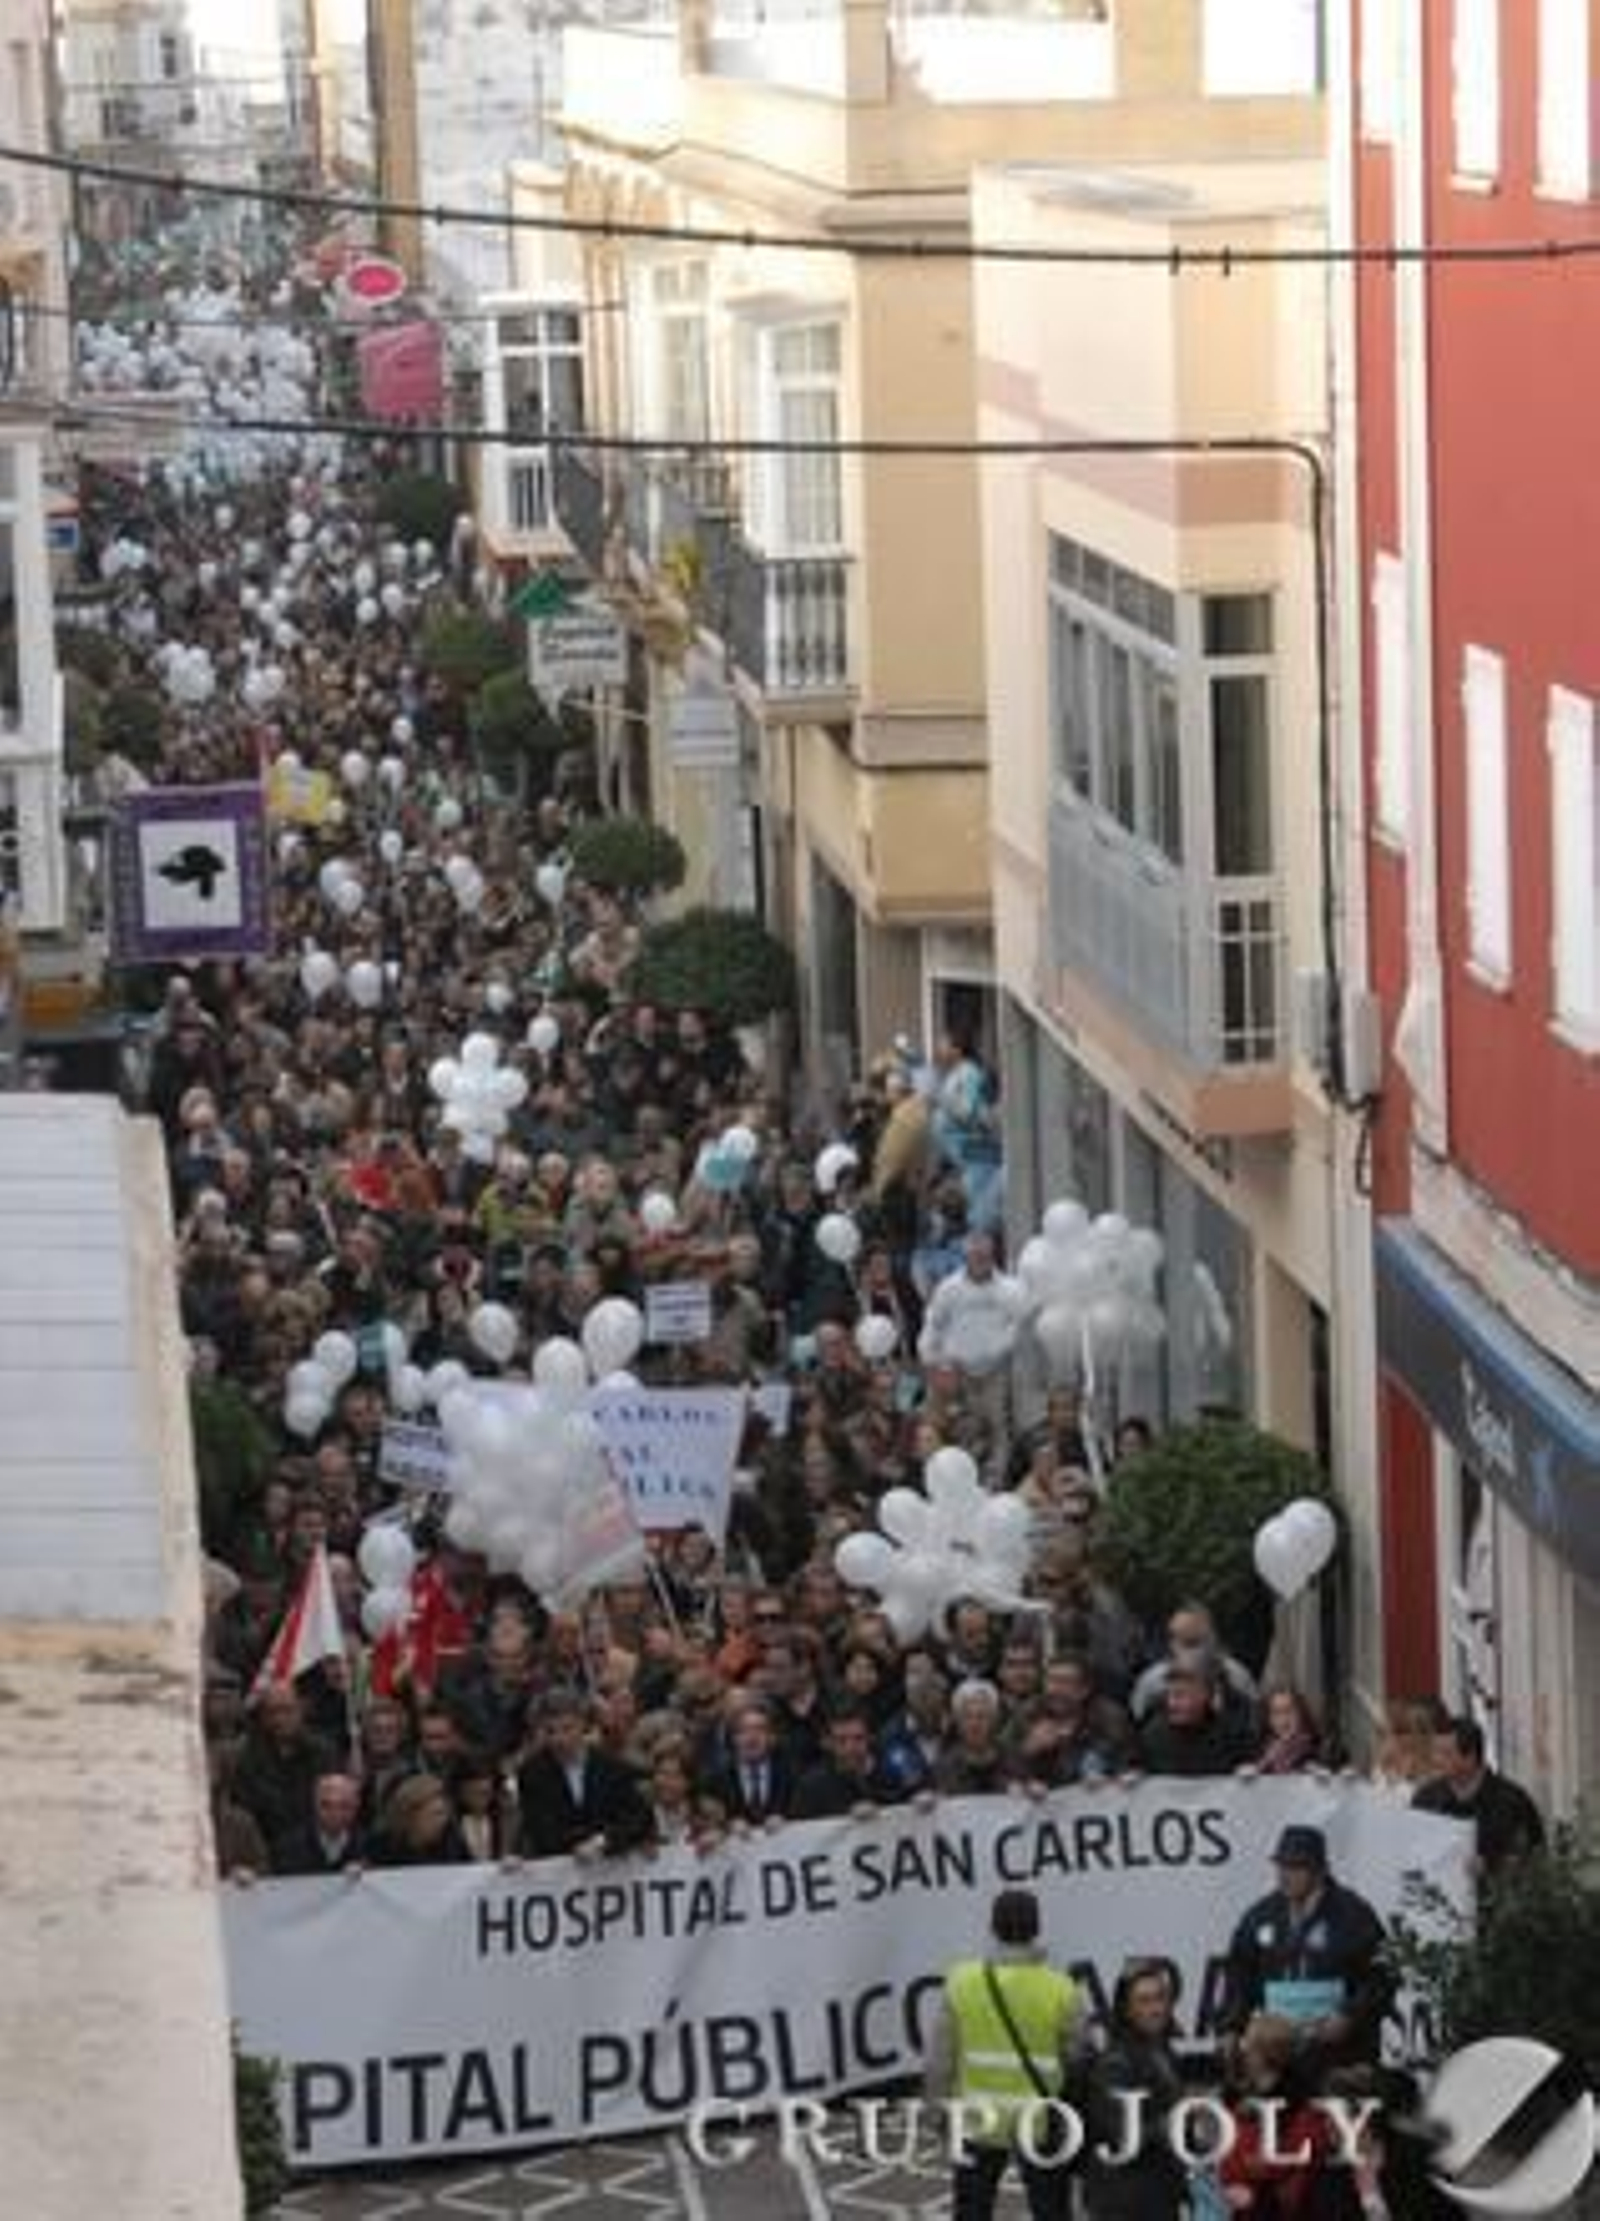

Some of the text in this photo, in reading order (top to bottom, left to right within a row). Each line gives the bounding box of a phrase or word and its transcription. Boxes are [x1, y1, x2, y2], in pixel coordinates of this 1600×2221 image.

[477, 1808, 1231, 1957] HOSPITAL DE SAN CARLOS
[291, 2044, 552, 2152] PITAL
